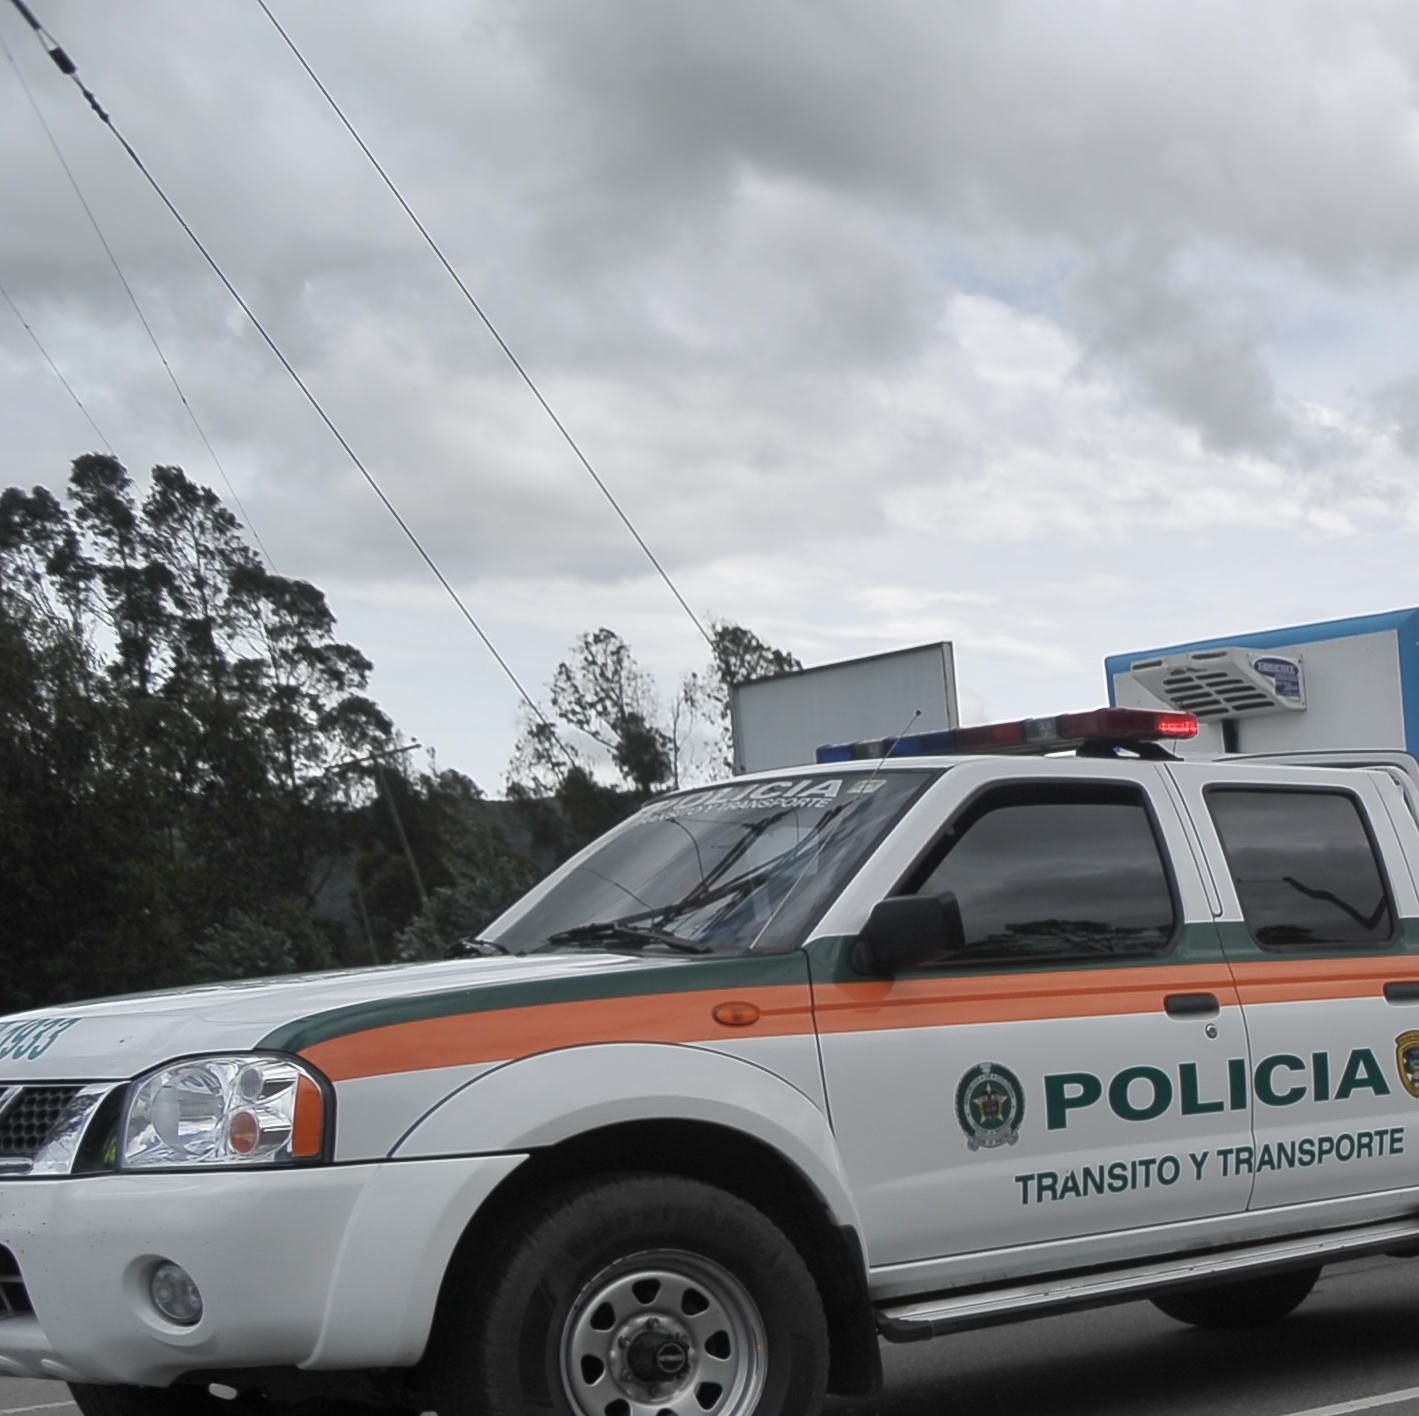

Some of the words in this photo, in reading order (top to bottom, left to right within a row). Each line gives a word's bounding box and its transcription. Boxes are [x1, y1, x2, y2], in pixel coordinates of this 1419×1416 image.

[0, 1017, 82, 1060] 1933
[1043, 1047, 1391, 1131] POLICIA
[1015, 1154, 1181, 1205] TRANSITO
[1188, 1151, 1210, 1181] Y
[1216, 1127, 1405, 1177] TRANSPORTE
